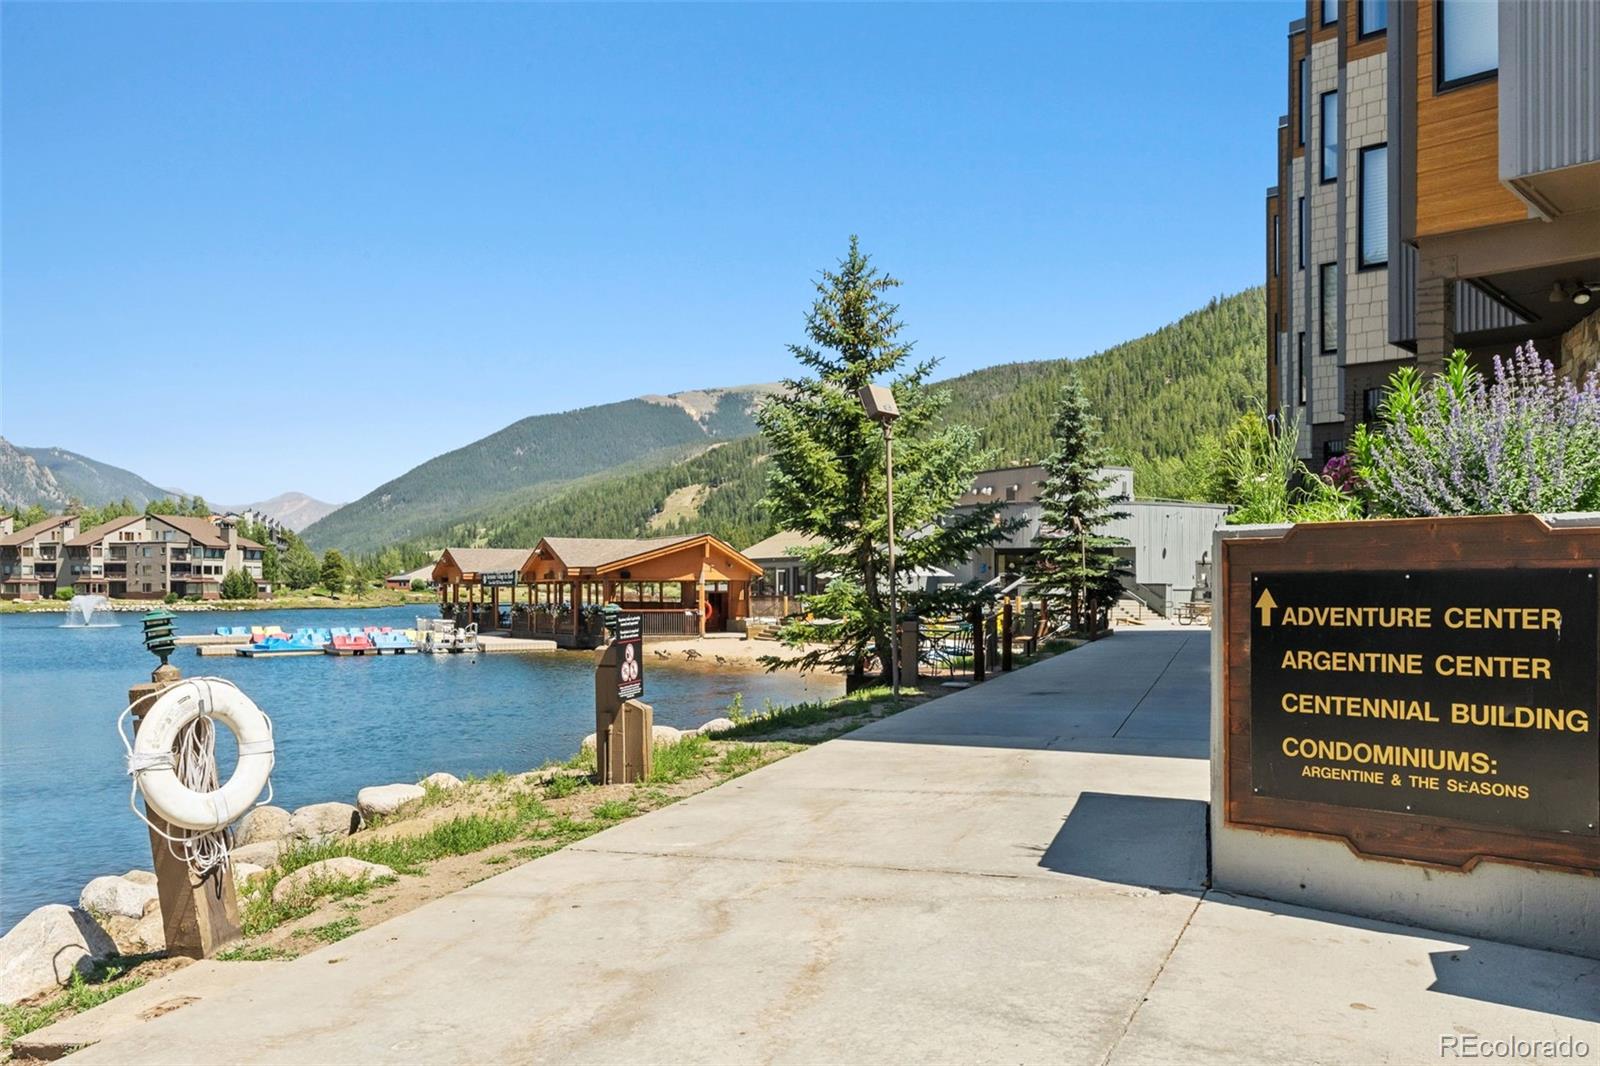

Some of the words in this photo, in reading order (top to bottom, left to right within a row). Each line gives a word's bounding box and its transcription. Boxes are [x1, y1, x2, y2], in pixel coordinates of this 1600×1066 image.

[1282, 607, 1432, 628] ADVENTURE
[1444, 607, 1562, 630] CENTER
[1281, 650, 1423, 675] ARGENTINE
[1435, 654, 1551, 680] CENTER
[1281, 692, 1440, 723] CENTENNIAL
[1451, 702, 1589, 733] BUILDING
[1282, 736, 1498, 775] CONDOMINIUMS:
[1301, 765, 1385, 785] ARGENTINE
[1390, 773, 1402, 787] &
[1408, 775, 1440, 791] THE
[1446, 778, 1530, 800] SEASONS
